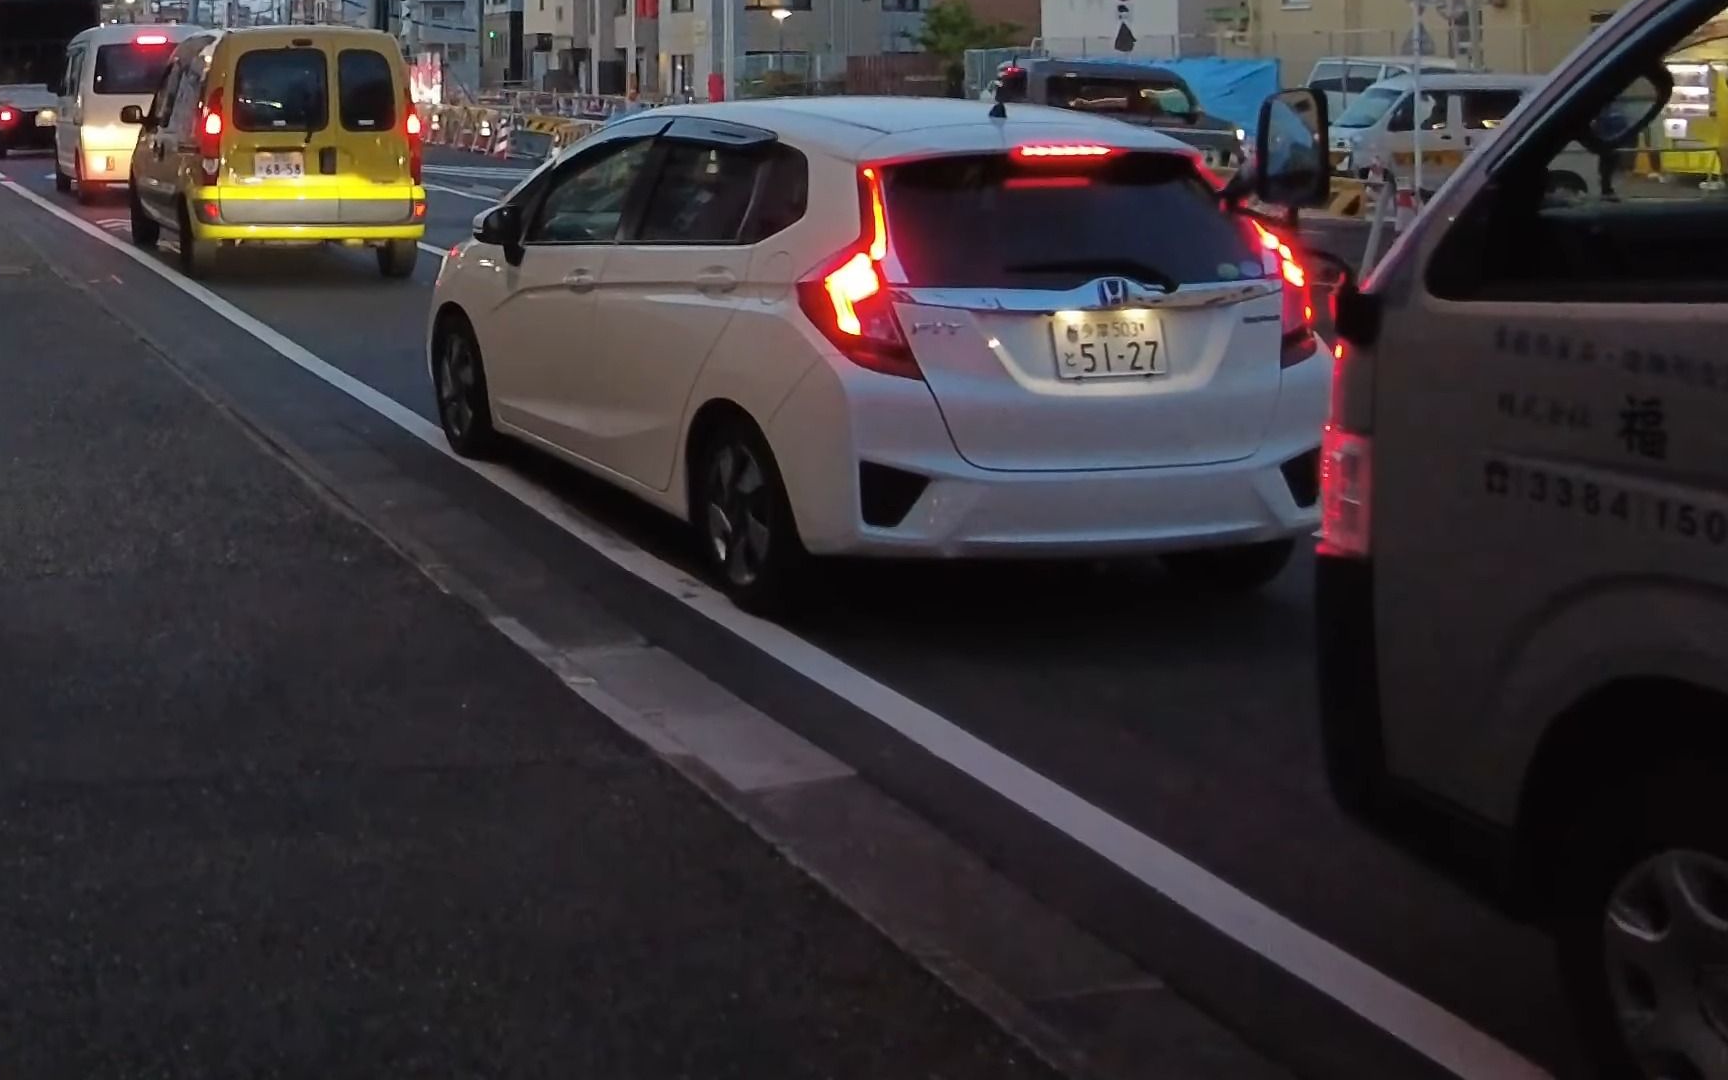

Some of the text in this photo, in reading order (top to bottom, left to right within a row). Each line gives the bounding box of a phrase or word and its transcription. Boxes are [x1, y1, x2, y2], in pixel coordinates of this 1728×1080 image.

[1112, 321, 1139, 338] 503
[1063, 340, 1159, 373] と 51-27
[1615, 392, 1669, 461] 福
[1528, 470, 1629, 521] 3384
